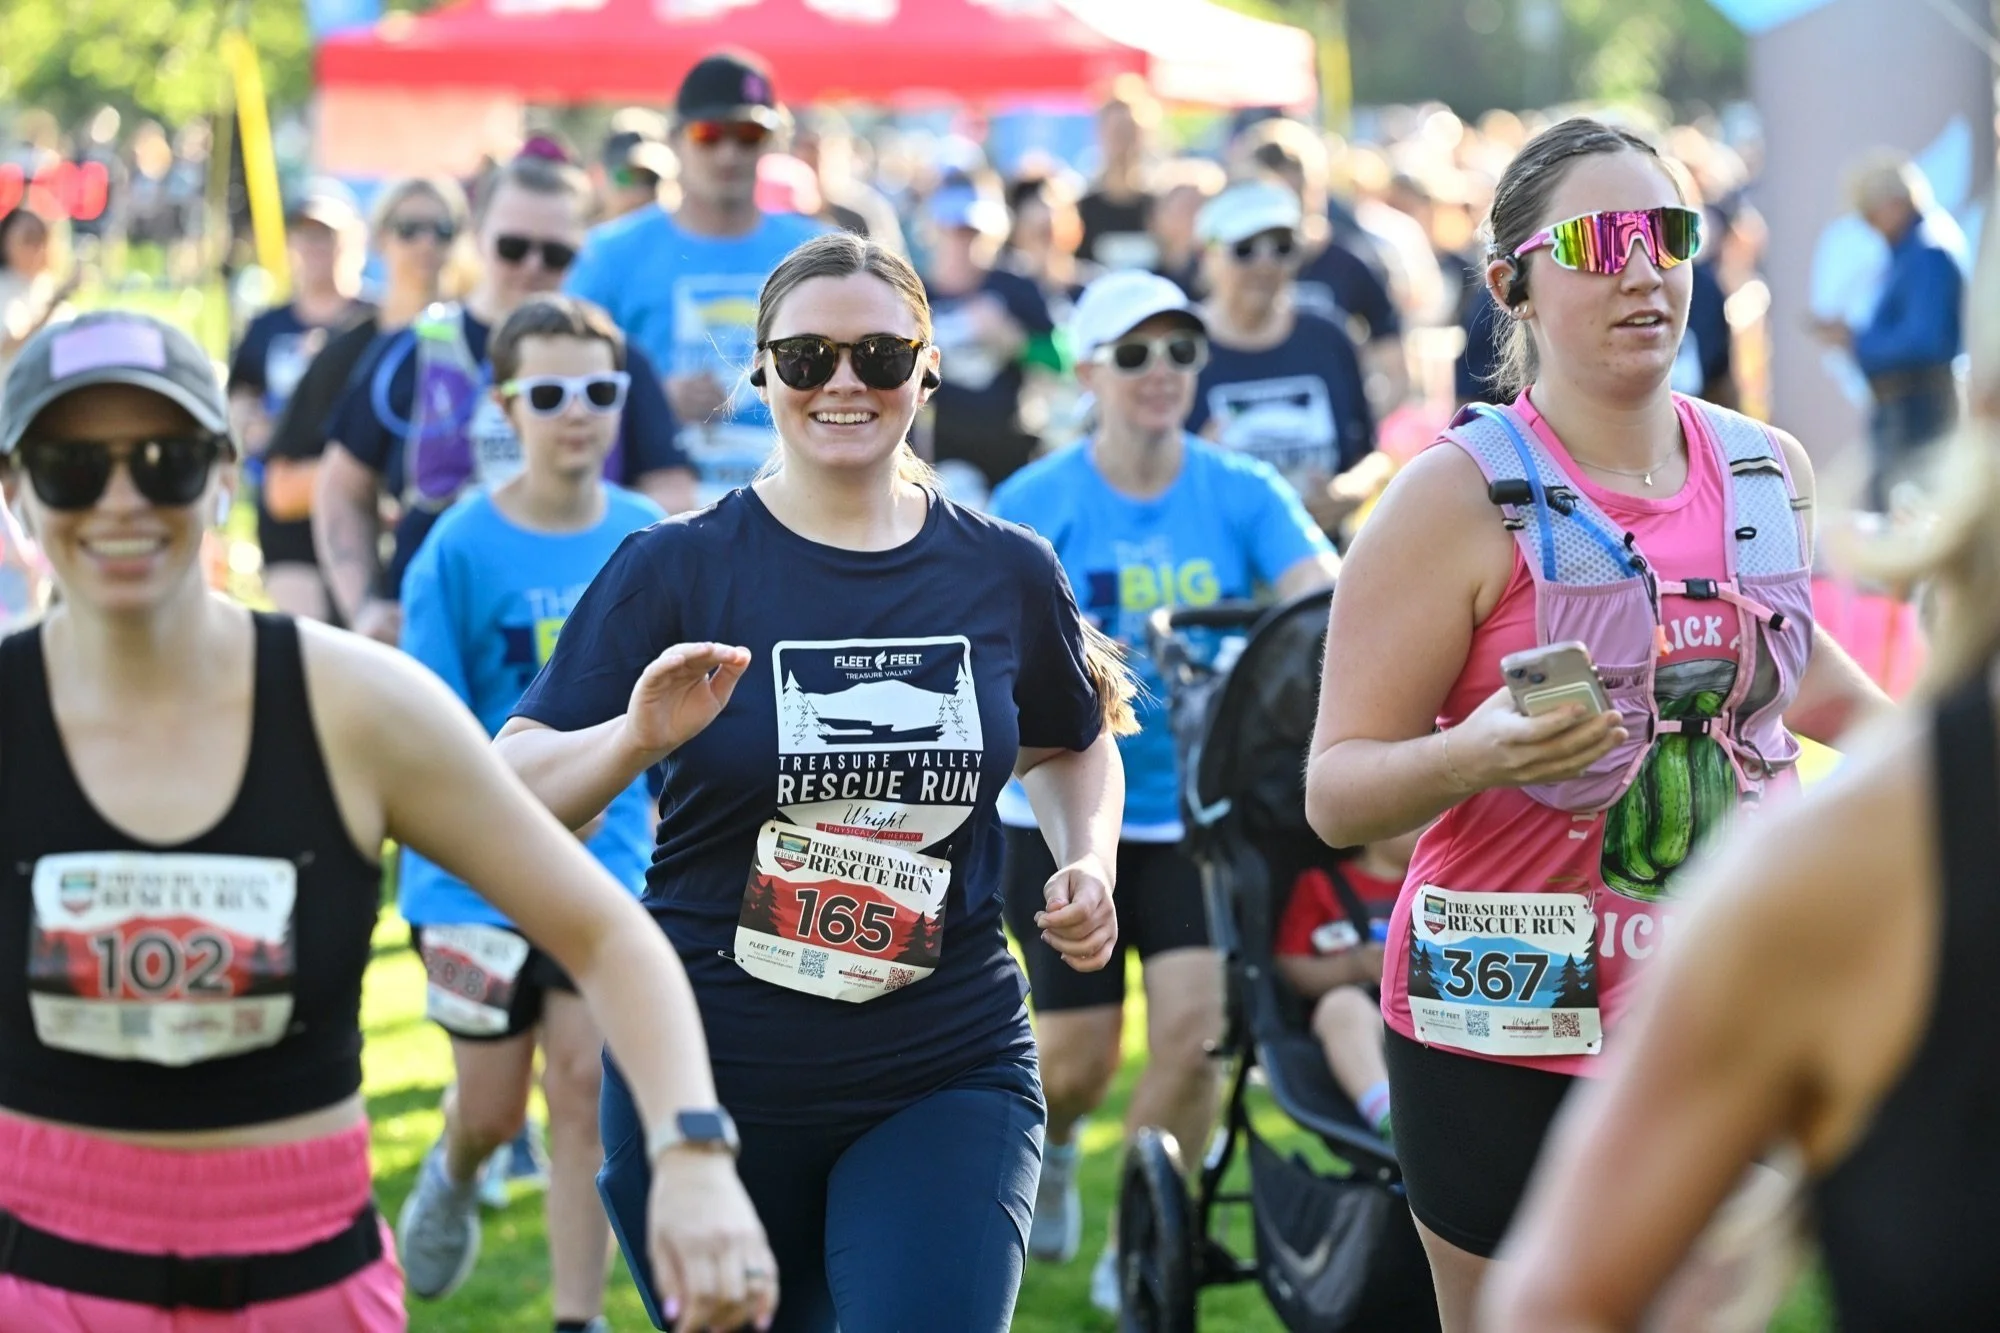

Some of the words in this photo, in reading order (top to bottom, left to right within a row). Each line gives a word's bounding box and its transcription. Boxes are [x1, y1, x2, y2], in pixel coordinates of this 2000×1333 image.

[1119, 557, 1219, 612] BIG
[1665, 615, 1722, 652] ICK
[834, 655, 872, 667] FLEET
[890, 654, 922, 666] FEET
[845, 671, 883, 680] TREASURE
[885, 669, 913, 677] VALLEY
[778, 753, 891, 772] TREASURE
[907, 752, 983, 768] VALLEY
[777, 771, 904, 804] RESCUE
[920, 770, 981, 803] RUN
[828, 824, 871, 837] PHYSICAL
[883, 831, 921, 842] THERAPY
[843, 803, 909, 838] Wright
[808, 856, 889, 887] RESCUE
[893, 873, 934, 896] RUN
[811, 841, 885, 869] TREASURE
[888, 857, 934, 878] VALLEY
[796, 887, 897, 952] 165
[1447, 902, 1519, 917] TREASURE
[1522, 904, 1576, 917] VALLEY
[1448, 914, 1527, 935] RESCUE
[1532, 917, 1576, 935] RUN
[88, 927, 234, 1000] 102
[749, 940, 771, 951] FLEET
[778, 948, 795, 957] FEET
[1442, 947, 1550, 1003] 367
[1422, 1008, 1439, 1016] FLEET
